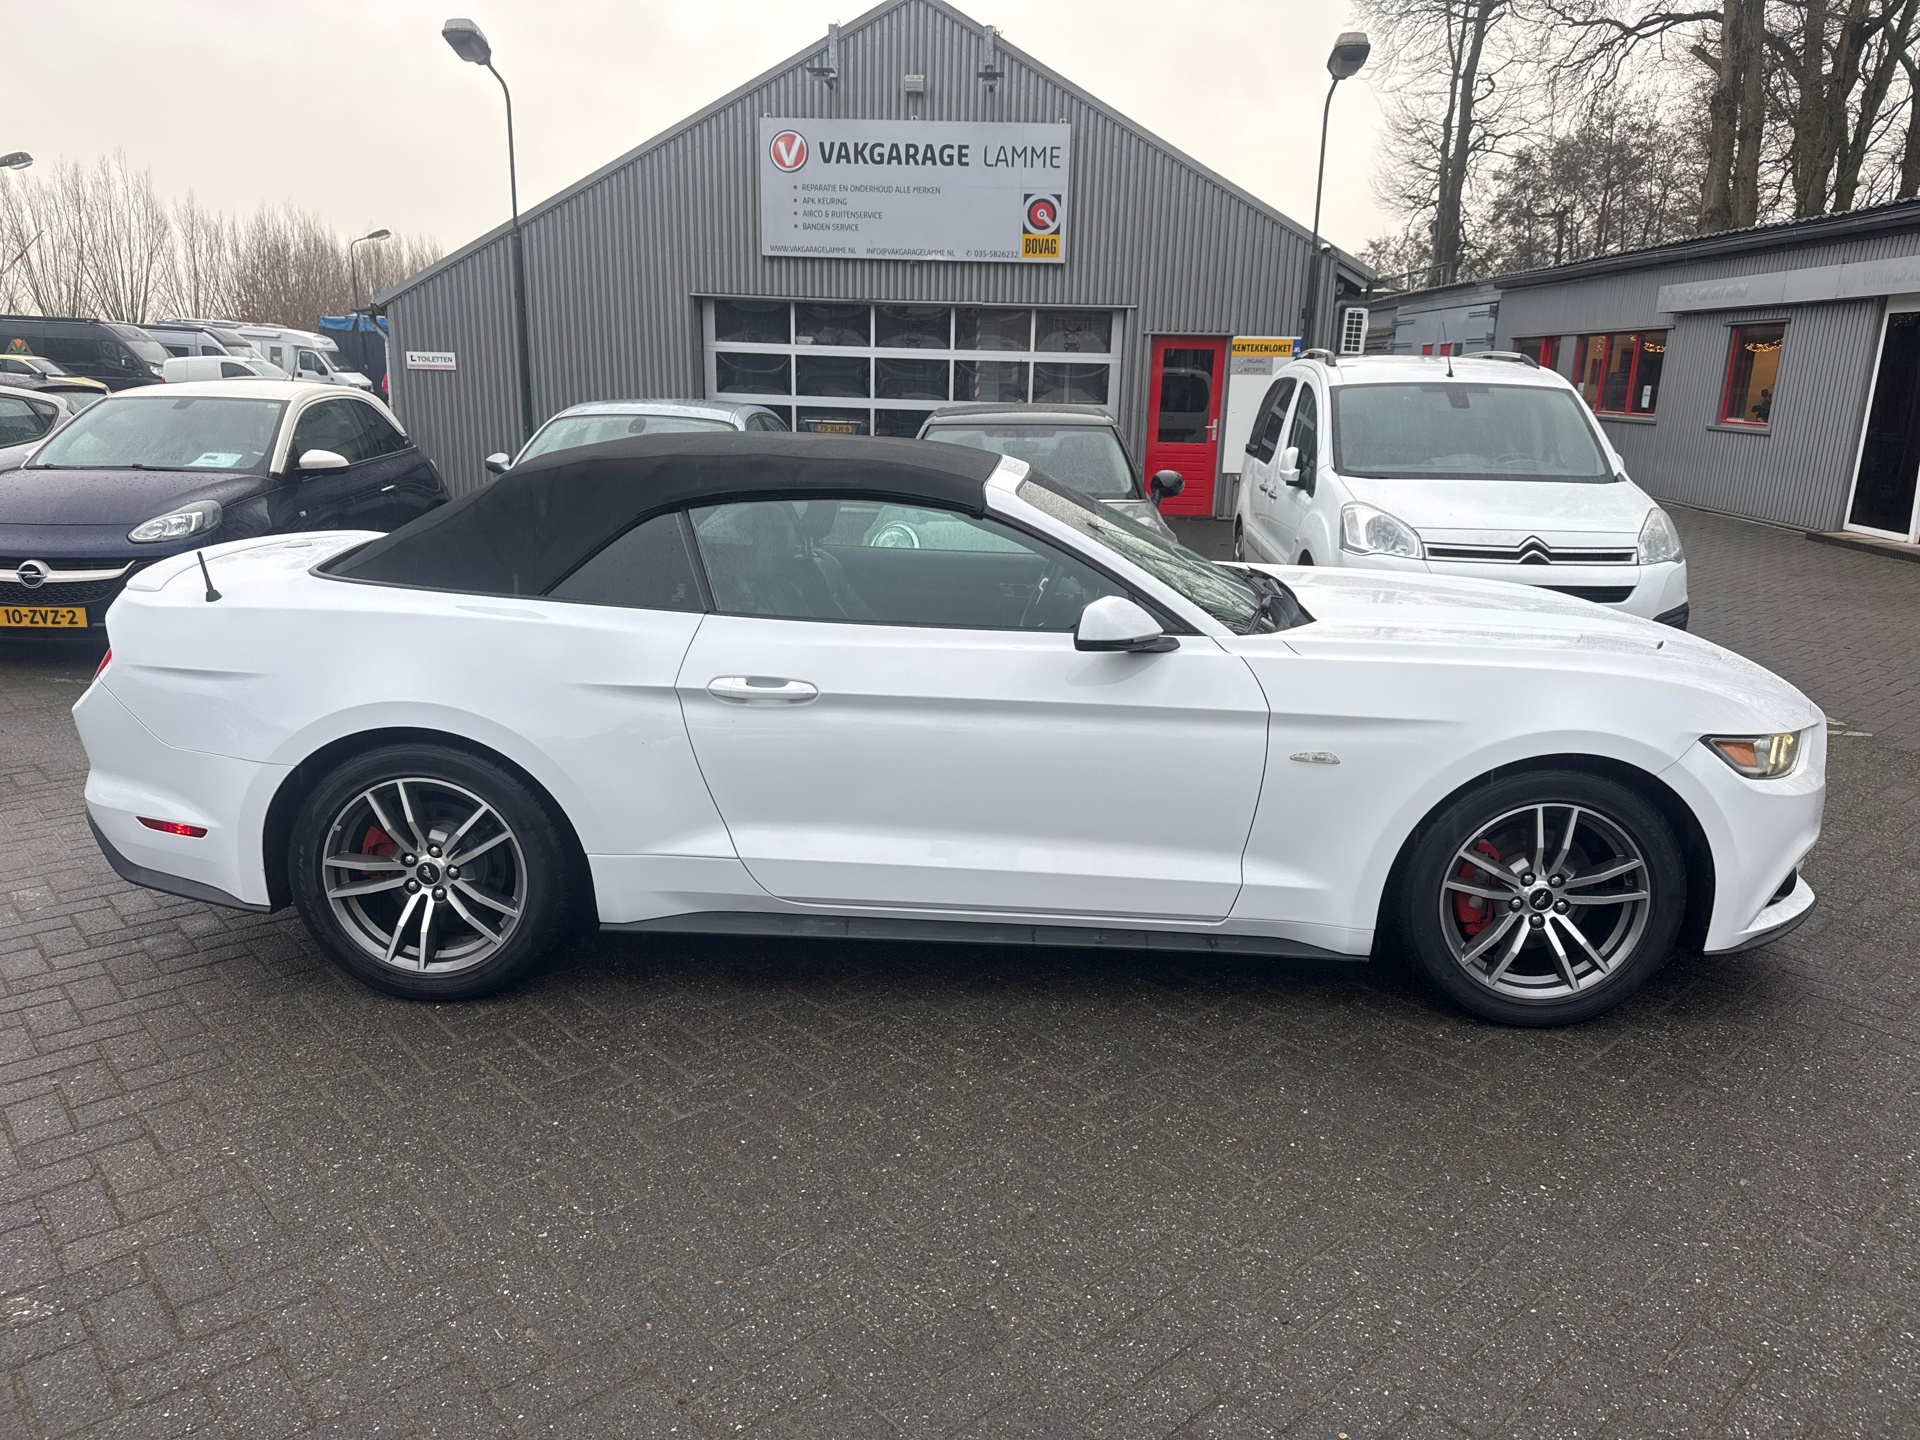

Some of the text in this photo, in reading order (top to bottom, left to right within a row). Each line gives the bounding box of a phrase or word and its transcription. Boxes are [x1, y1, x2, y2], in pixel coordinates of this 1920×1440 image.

[819, 141, 1061, 169] VAKGARAGE LAMME
[801, 184, 837, 192] REPARATIE
[850, 185, 894, 194] ONDERHOUD
[895, 186, 911, 194] ALLE
[912, 186, 941, 194] MERKEN
[802, 197, 848, 206] APK KEURING
[802, 210, 823, 218] AIRCO
[831, 210, 883, 219] RUITENSERVICE
[802, 223, 859, 232] BANDEN SERVICE
[1025, 238, 1057, 255] BOVAG
[1232, 343, 1292, 353] KENTEKENLOKET
[417, 355, 453, 363] TOILETTEN
[4, 608, 79, 625] 10-ZVZ-2
